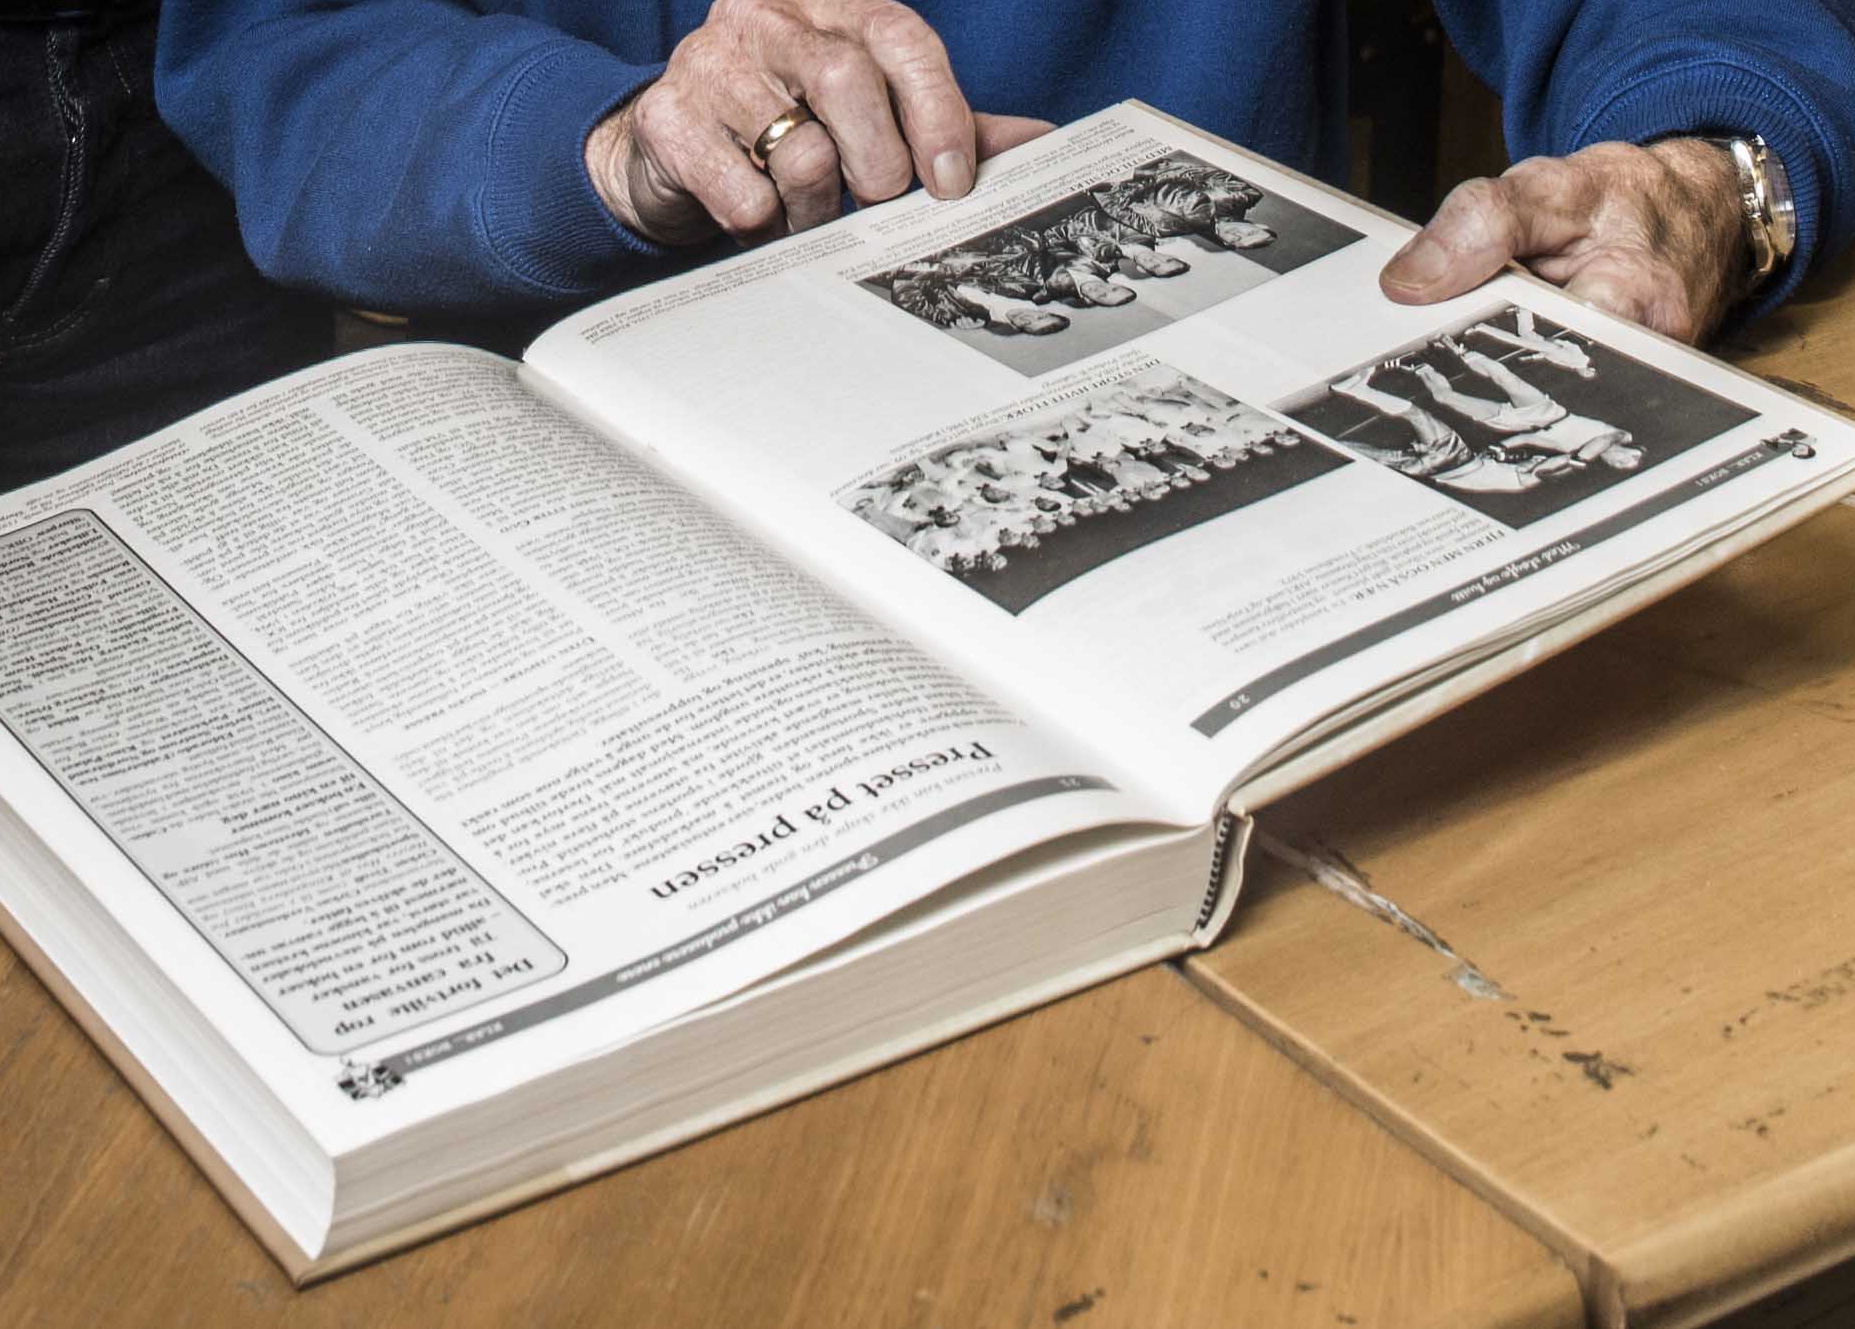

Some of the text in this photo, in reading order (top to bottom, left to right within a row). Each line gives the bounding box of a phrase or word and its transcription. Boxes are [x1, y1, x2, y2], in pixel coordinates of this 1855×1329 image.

[1227, 693, 1250, 709] 20
[650, 741, 993, 898] Presset på pressen
[334, 958, 533, 1035] Det fortvilte rop
[342, 951, 494, 1010] fra canvasen
